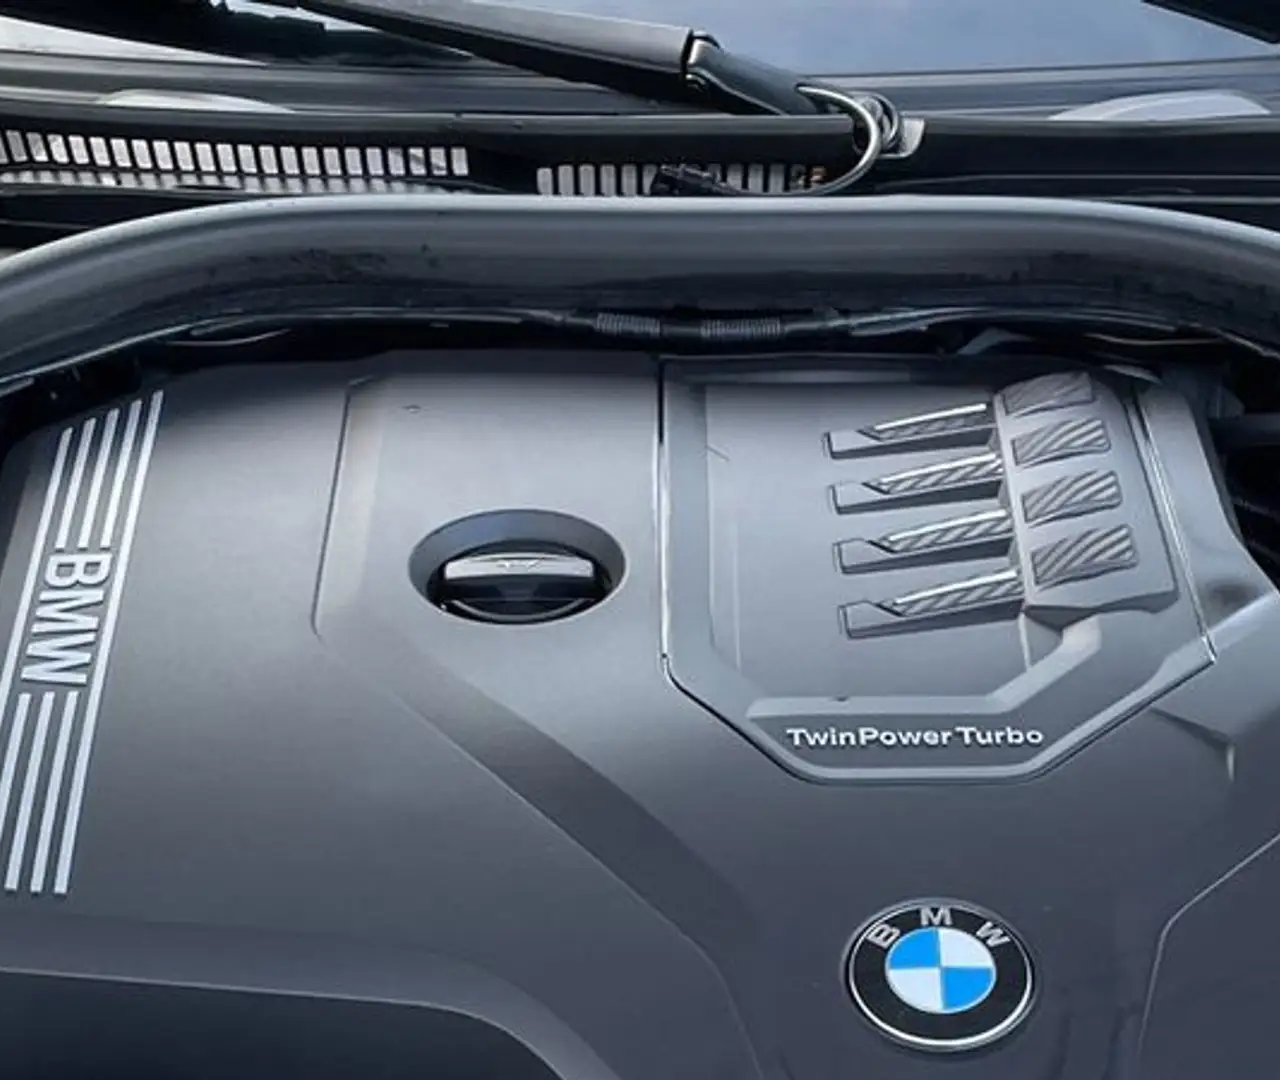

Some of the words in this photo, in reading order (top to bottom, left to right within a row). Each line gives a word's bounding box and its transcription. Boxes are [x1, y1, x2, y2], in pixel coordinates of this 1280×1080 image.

[20, 552, 113, 685] BMW
[955, 726, 1045, 746] Turbo
[867, 906, 1011, 949] BMW
